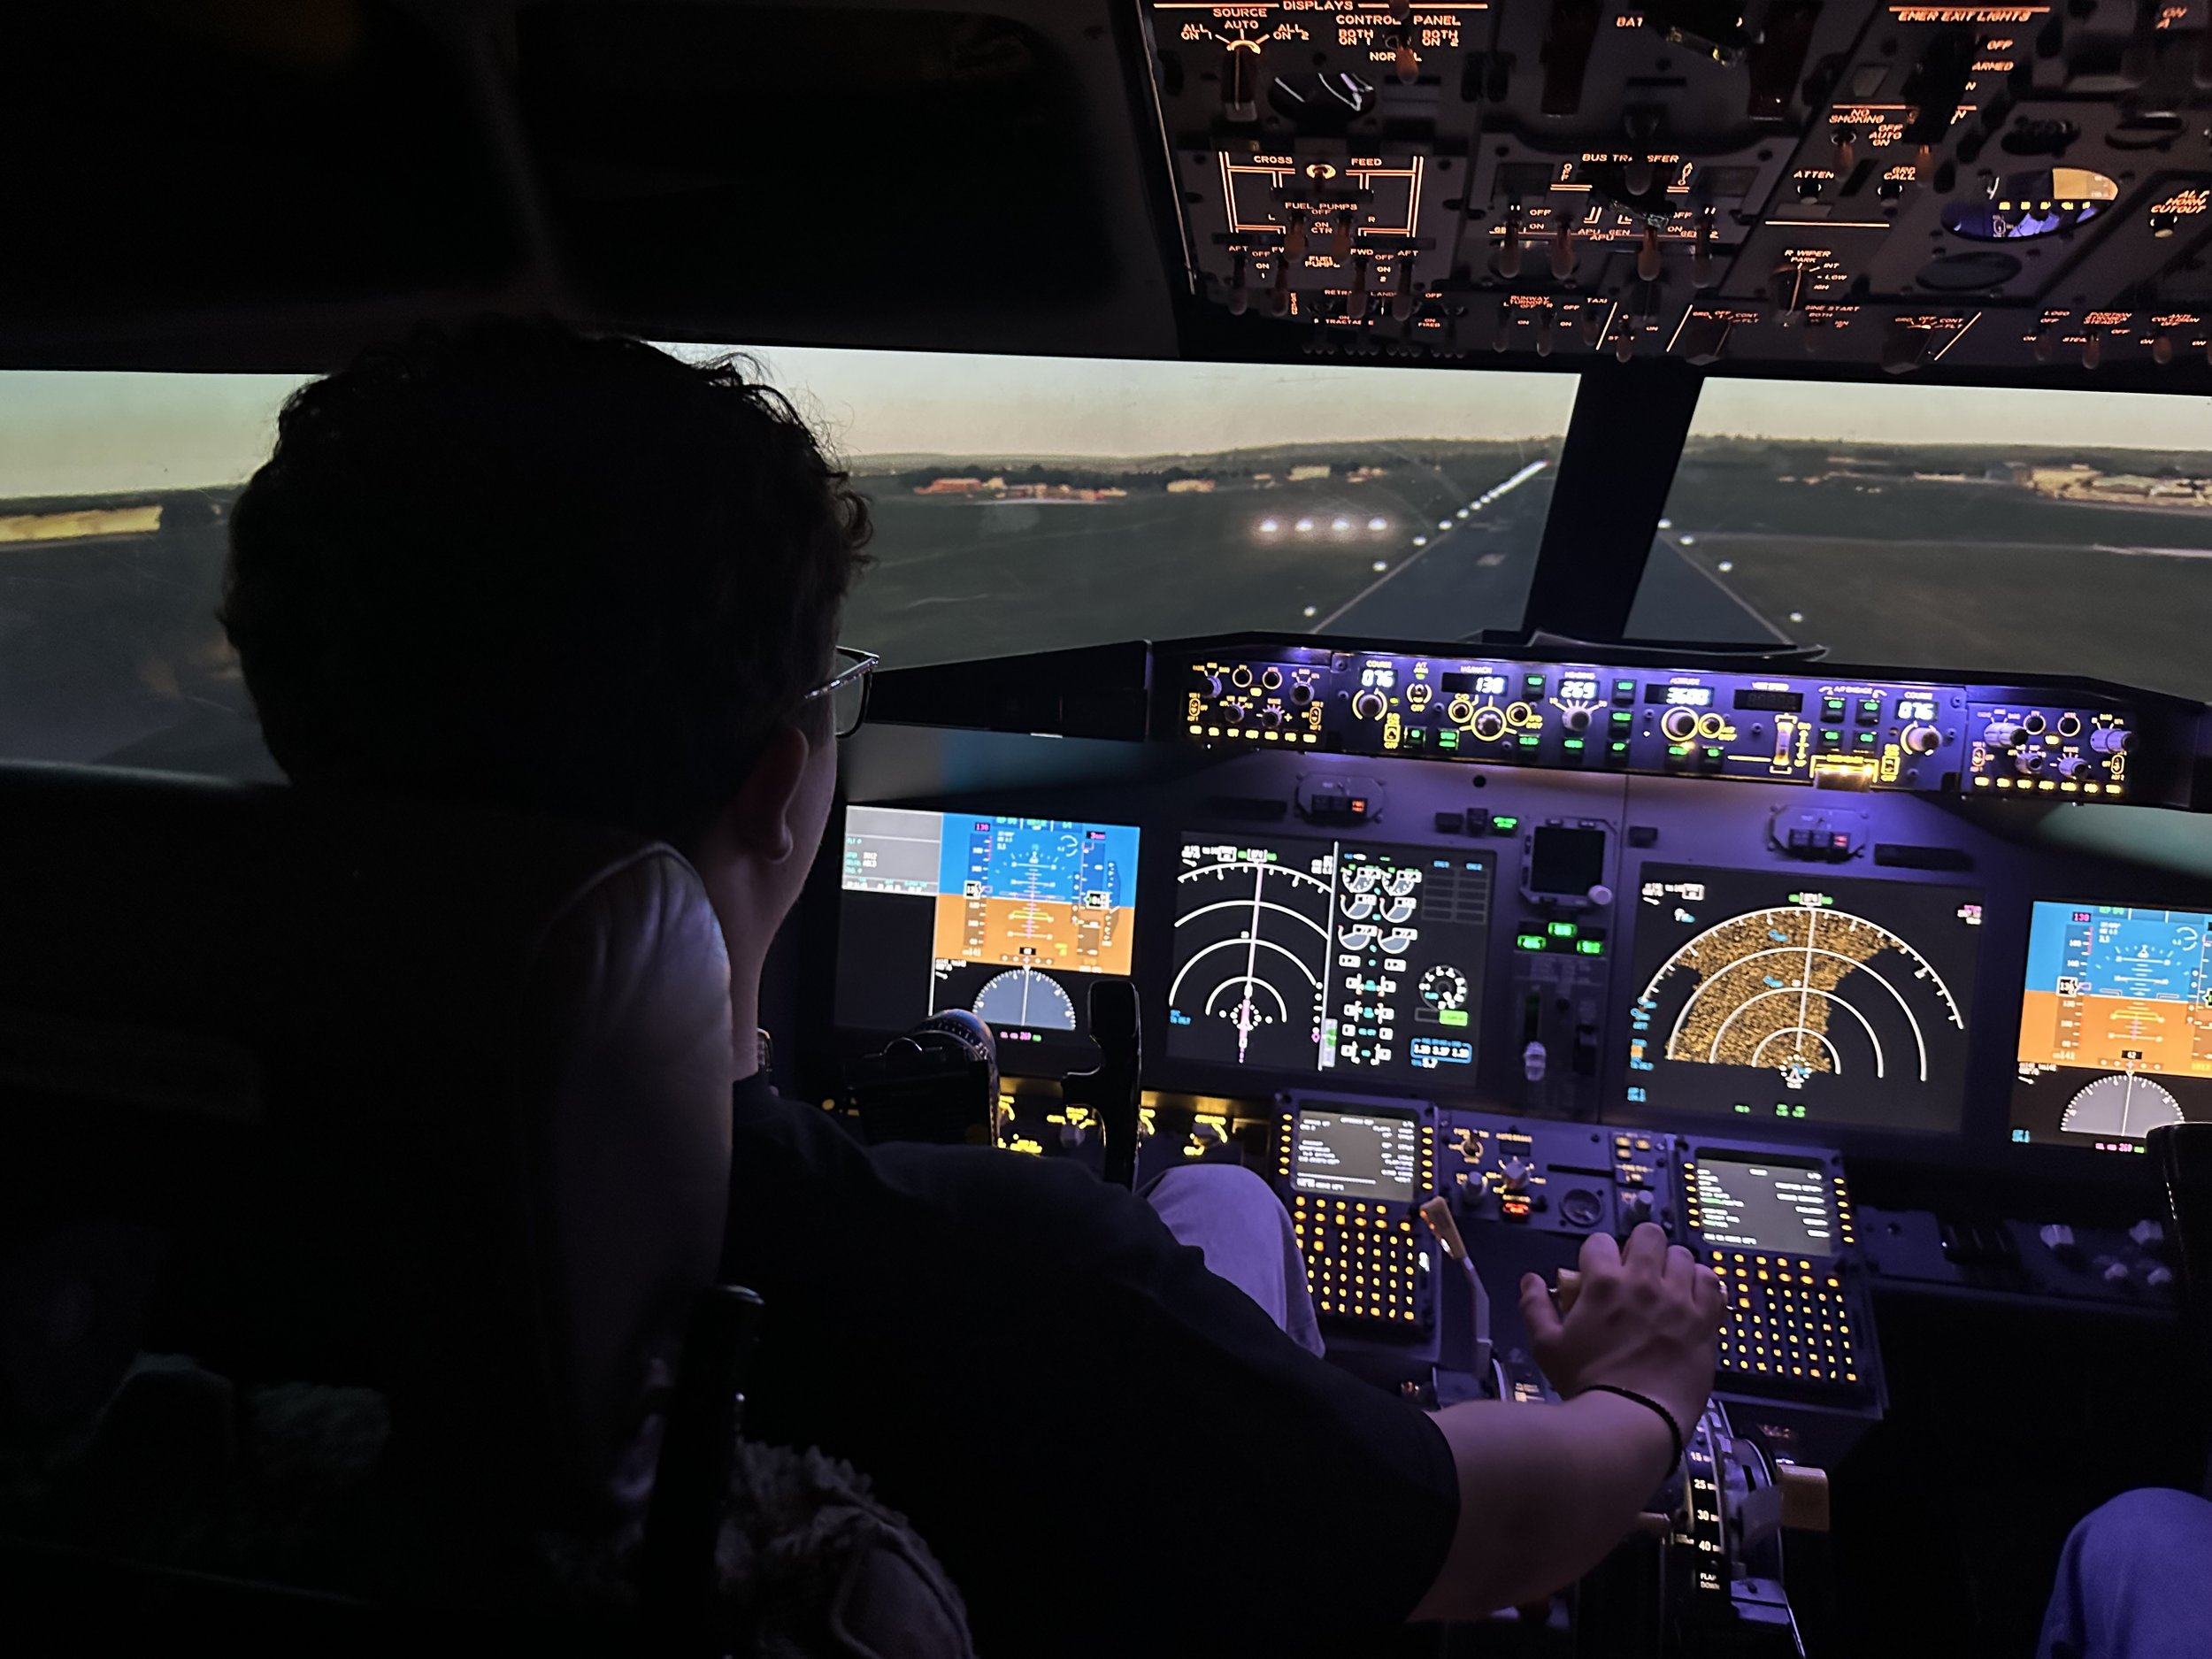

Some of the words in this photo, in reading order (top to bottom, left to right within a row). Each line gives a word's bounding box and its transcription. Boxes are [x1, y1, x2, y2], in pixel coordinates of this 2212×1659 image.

[1283, 1, 1353, 11] DISPLAYS
[1213, 8, 1267, 18] SOURCE
[1225, 20, 1259, 29] AUTO
[1336, 14, 1402, 25] CONTROL
[1413, 15, 1461, 26] PANEL
[1183, 24, 1209, 33] ALL
[1278, 24, 1303, 33] ALL
[1181, 31, 1199, 40] ON
[1273, 31, 1291, 40] ON
[1339, 29, 1373, 39] BOTH
[1422, 29, 1458, 39] BOTH
[1422, 37, 1440, 46] ON
[1986, 39, 2014, 50] OFF
[1370, 51, 1422, 61] NORL
[1254, 155, 1293, 165] CROSS
[1351, 157, 1382, 166] FEED
[1793, 170, 1834, 179] ATTEN
[1697, 1509, 1709, 1521] 30
[1699, 1540, 1711, 1551] 40
